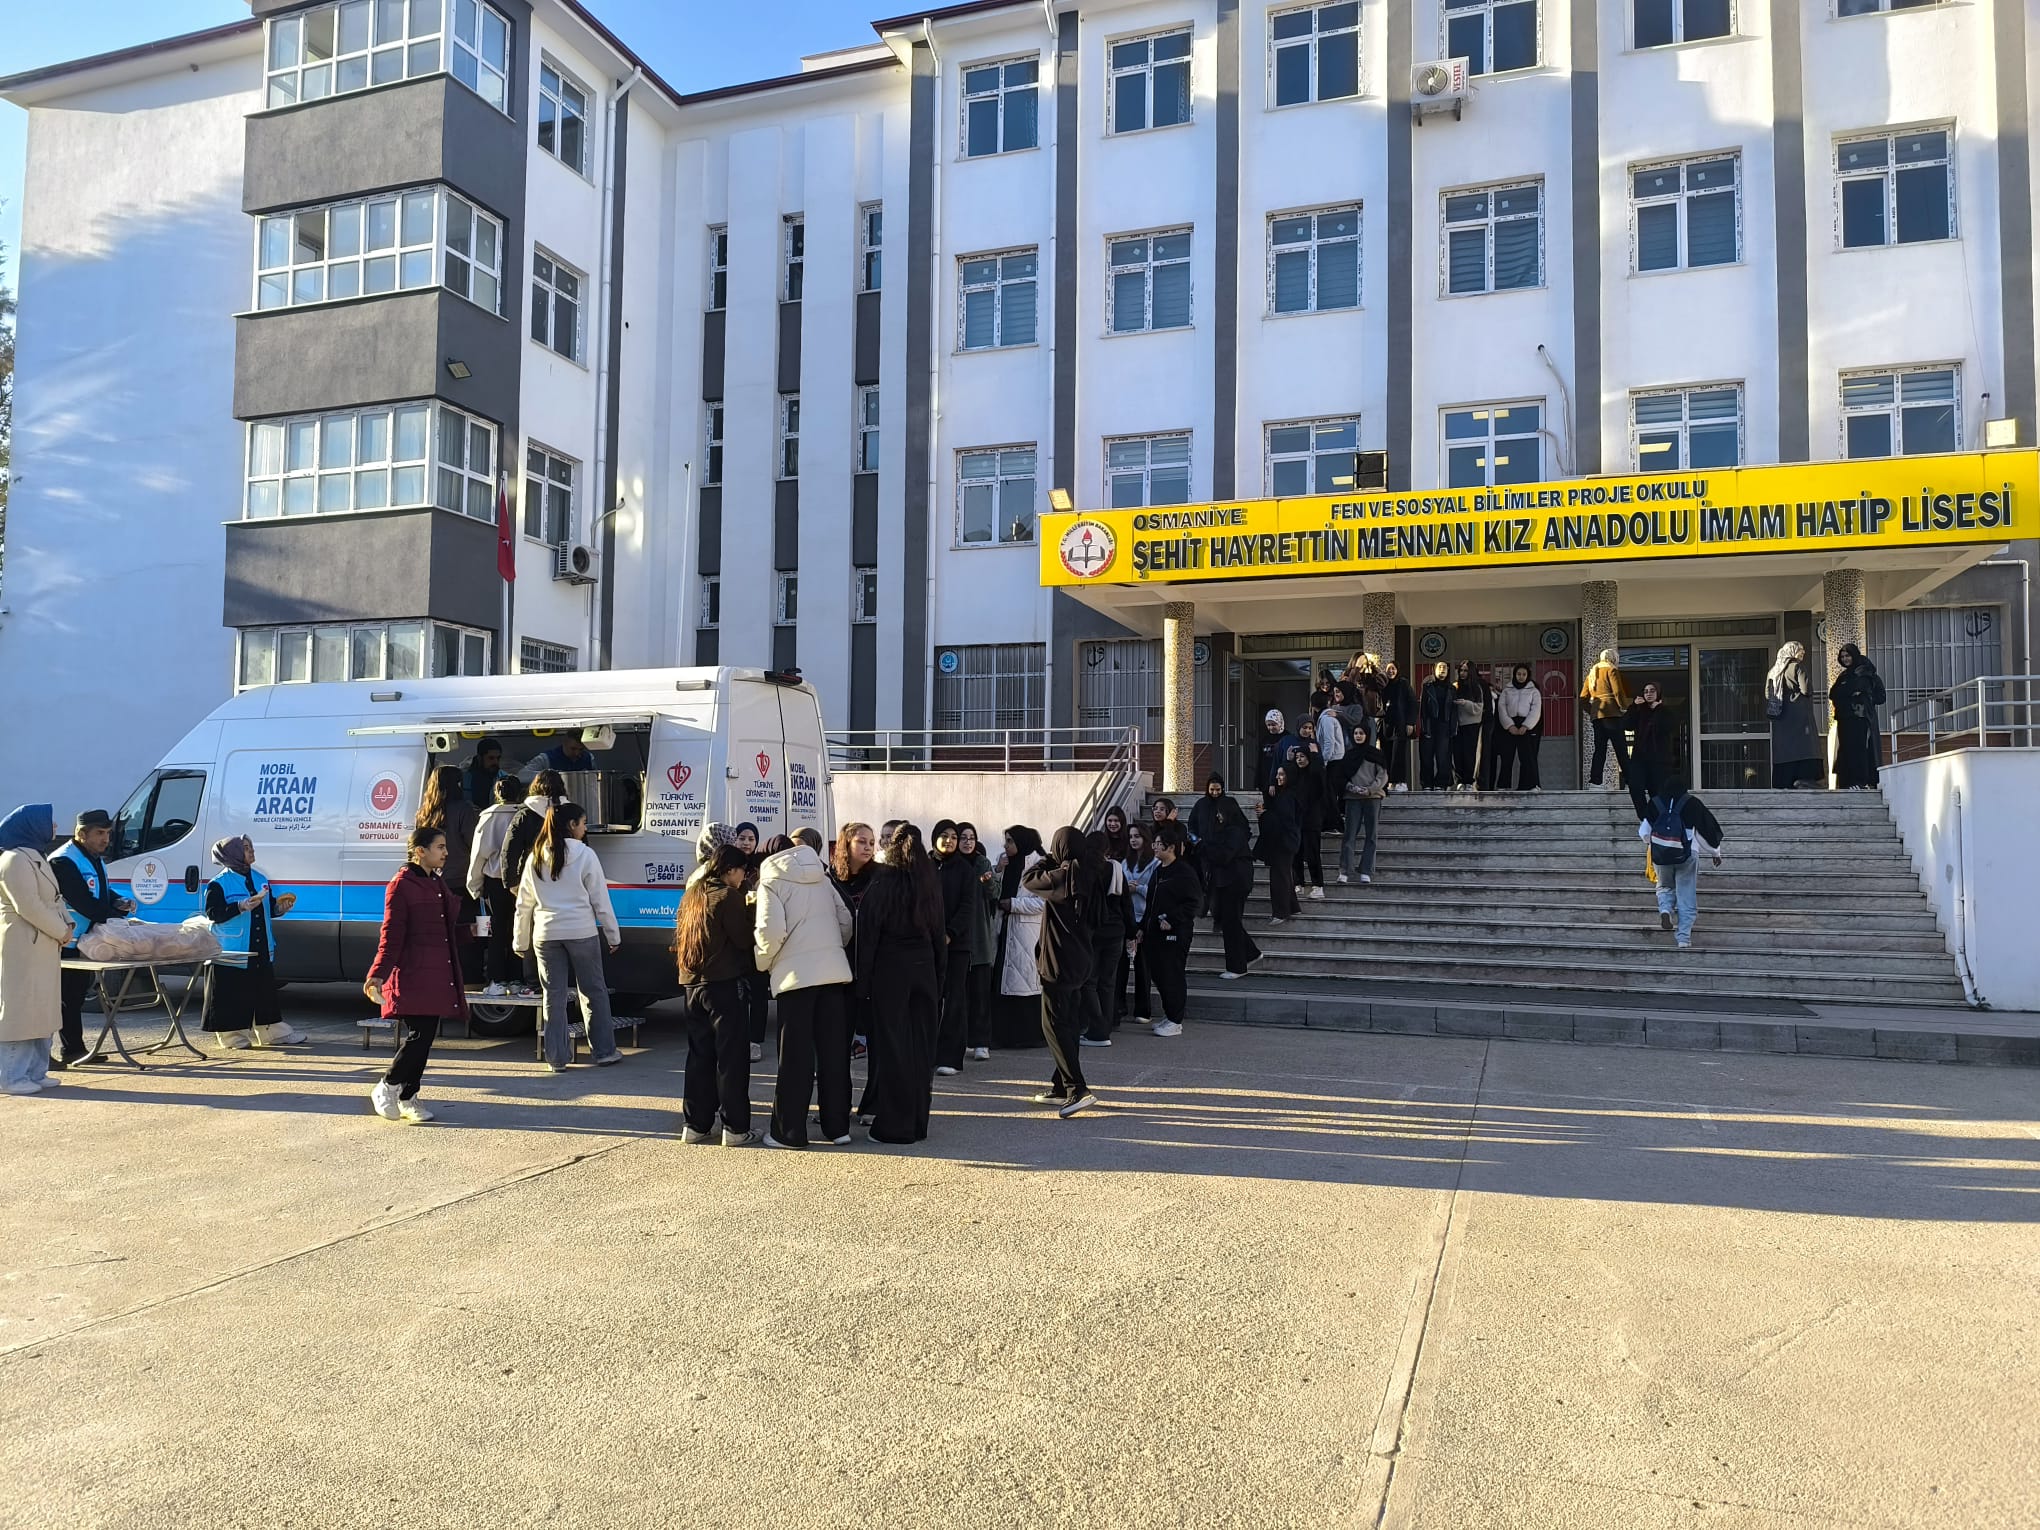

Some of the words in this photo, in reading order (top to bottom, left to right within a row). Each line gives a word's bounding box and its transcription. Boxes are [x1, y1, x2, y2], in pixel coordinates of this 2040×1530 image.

[1331, 502, 1365, 520] FEN
[1369, 500, 1393, 518] VE
[1396, 496, 1467, 515] SOSYAL
[1474, 488, 1562, 512] BİLİMLER
[1568, 484, 1631, 506] PROJE
[1637, 480, 1707, 501] OKULU
[1133, 506, 1244, 530] OSMANİYE
[1133, 531, 1203, 578] ŞEHİT
[1210, 521, 1350, 568] HAYRETTİN
[1357, 521, 1475, 560] MENNAN
[1484, 518, 1533, 553] KIZ
[1542, 509, 1689, 551] ANADOLU
[1699, 499, 1786, 543] İMAM
[1795, 490, 1891, 538] HATİP
[1901, 481, 2013, 532] LİSESİ
[660, 791, 694, 801] TÜRKİYE
[791, 791, 816, 808] ARACI
[254, 796, 314, 815] ARACI
[646, 800, 680, 810] DİYANET
[749, 805, 779, 815] OSMANİYE
[358, 820, 403, 830] OSMANİYE
[650, 817, 700, 827] OSMANİYE
[359, 832, 400, 840] MÜFTÜLÜĞÜ
[661, 828, 688, 837] ŞUBESİ
[656, 872, 675, 881] 5601
